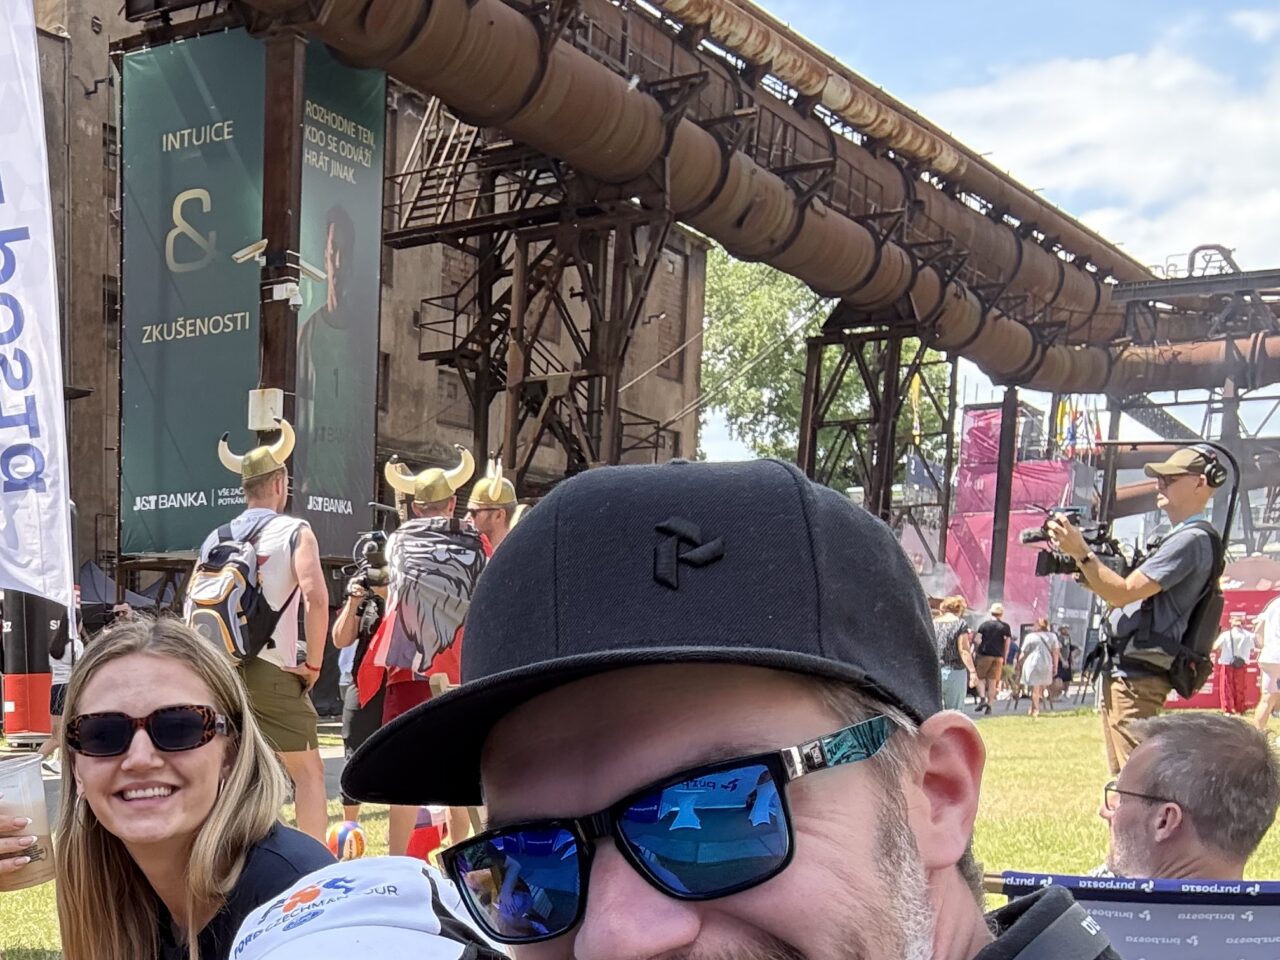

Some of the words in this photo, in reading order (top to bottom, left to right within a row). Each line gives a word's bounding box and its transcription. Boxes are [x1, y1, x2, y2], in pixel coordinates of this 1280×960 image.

[162, 120, 234, 152] INTUICE
[305, 101, 356, 136] ROZHODNE
[357, 125, 376, 148] TEN,
[305, 125, 325, 147] KDO
[327, 132, 338, 151] SE
[339, 139, 372, 168] ODVÁŽÍ
[305, 148, 329, 172] HRÁT
[329, 160, 357, 184] JINAK.
[142, 312, 250, 344] ZKUŠENOSTI
[158, 491, 207, 509] BANKA
[323, 497, 353, 515] BANKA
